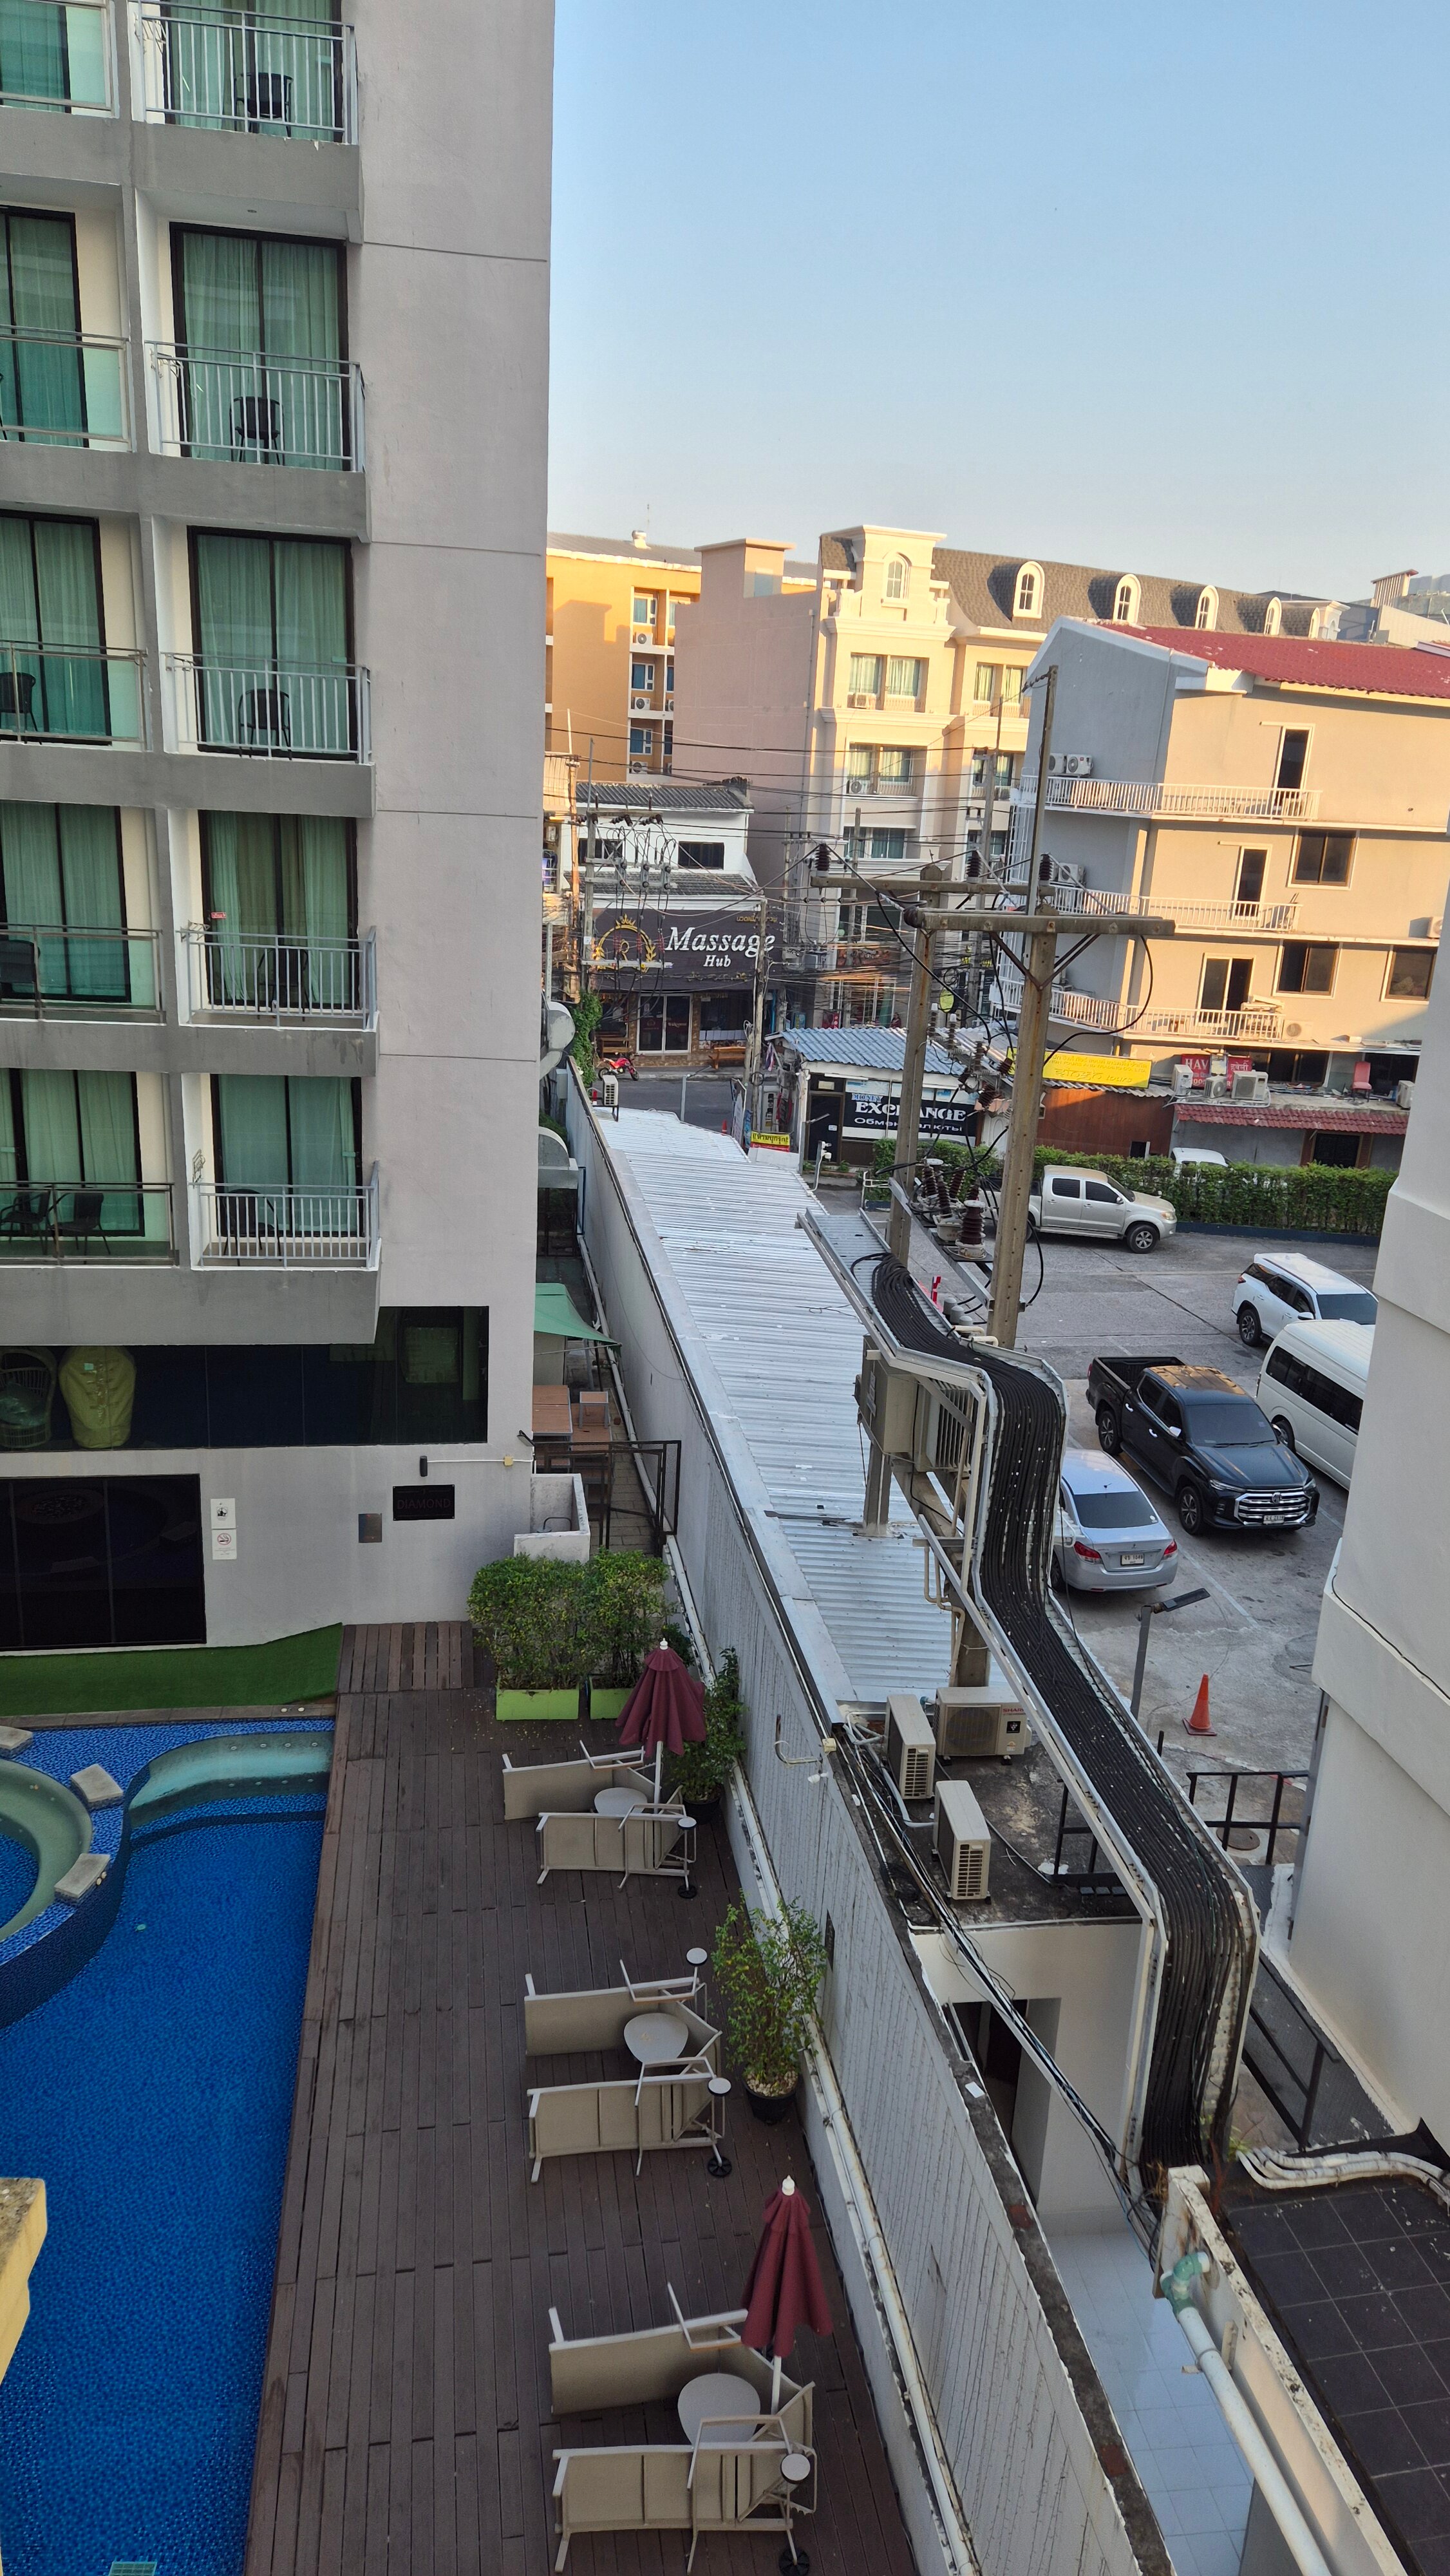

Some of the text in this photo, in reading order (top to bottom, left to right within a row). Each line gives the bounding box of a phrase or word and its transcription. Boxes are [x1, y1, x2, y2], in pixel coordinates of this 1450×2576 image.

[664, 927, 775, 958] Massage
[703, 954, 731, 967] Hub
[851, 1092, 883, 1103] MONEY
[397, 1499, 451, 1510] DIAMOND
